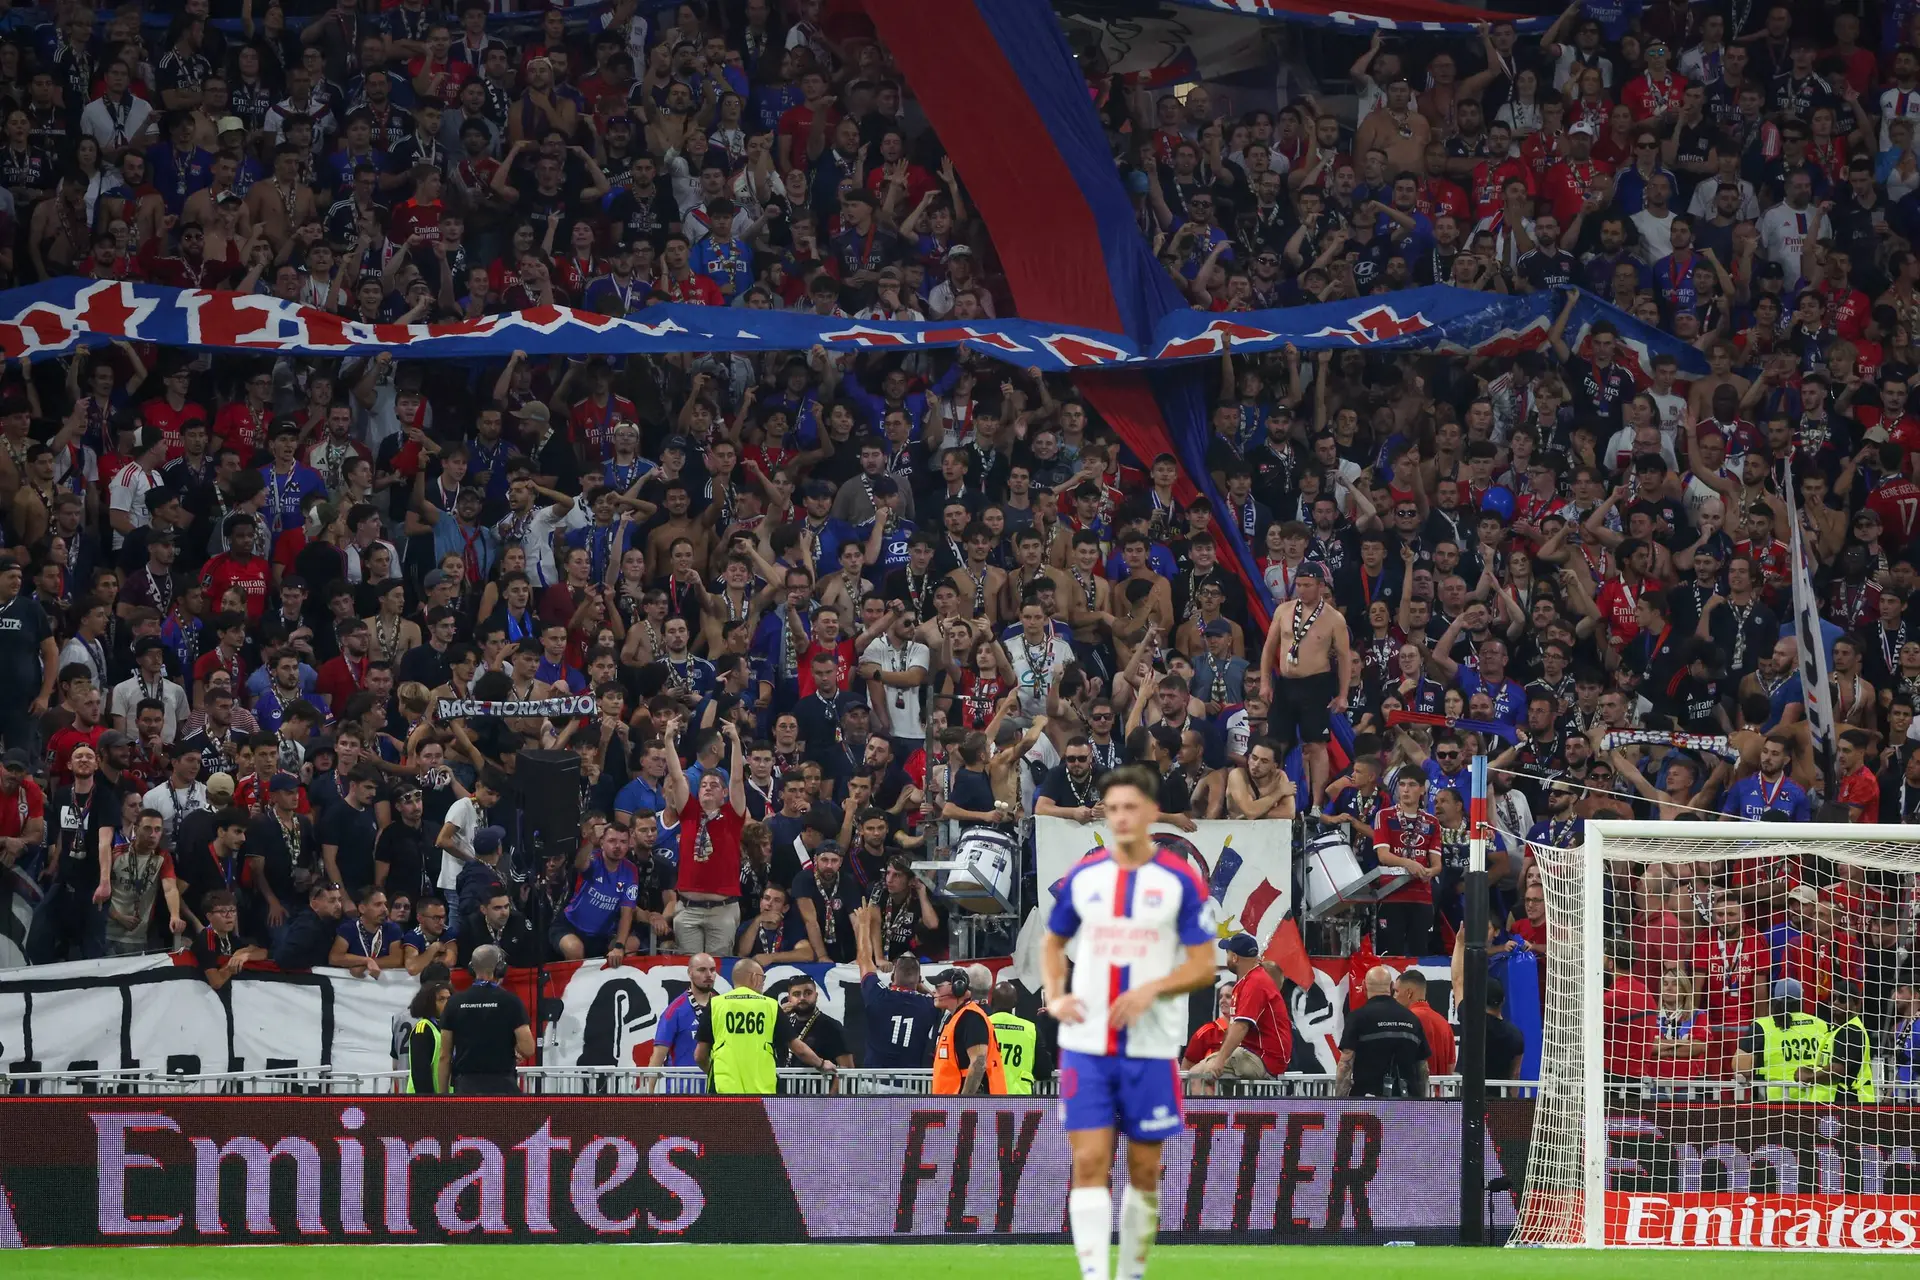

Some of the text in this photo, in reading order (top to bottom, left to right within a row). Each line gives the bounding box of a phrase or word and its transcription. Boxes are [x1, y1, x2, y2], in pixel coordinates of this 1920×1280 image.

[1897, 497, 1918, 534] 17
[725, 1011, 765, 1035] 0266
[890, 1015, 914, 1047] 11
[87, 1106, 706, 1236] Emirates
[893, 1109, 1044, 1235] FLY
[1624, 1196, 1918, 1249] Emirates
